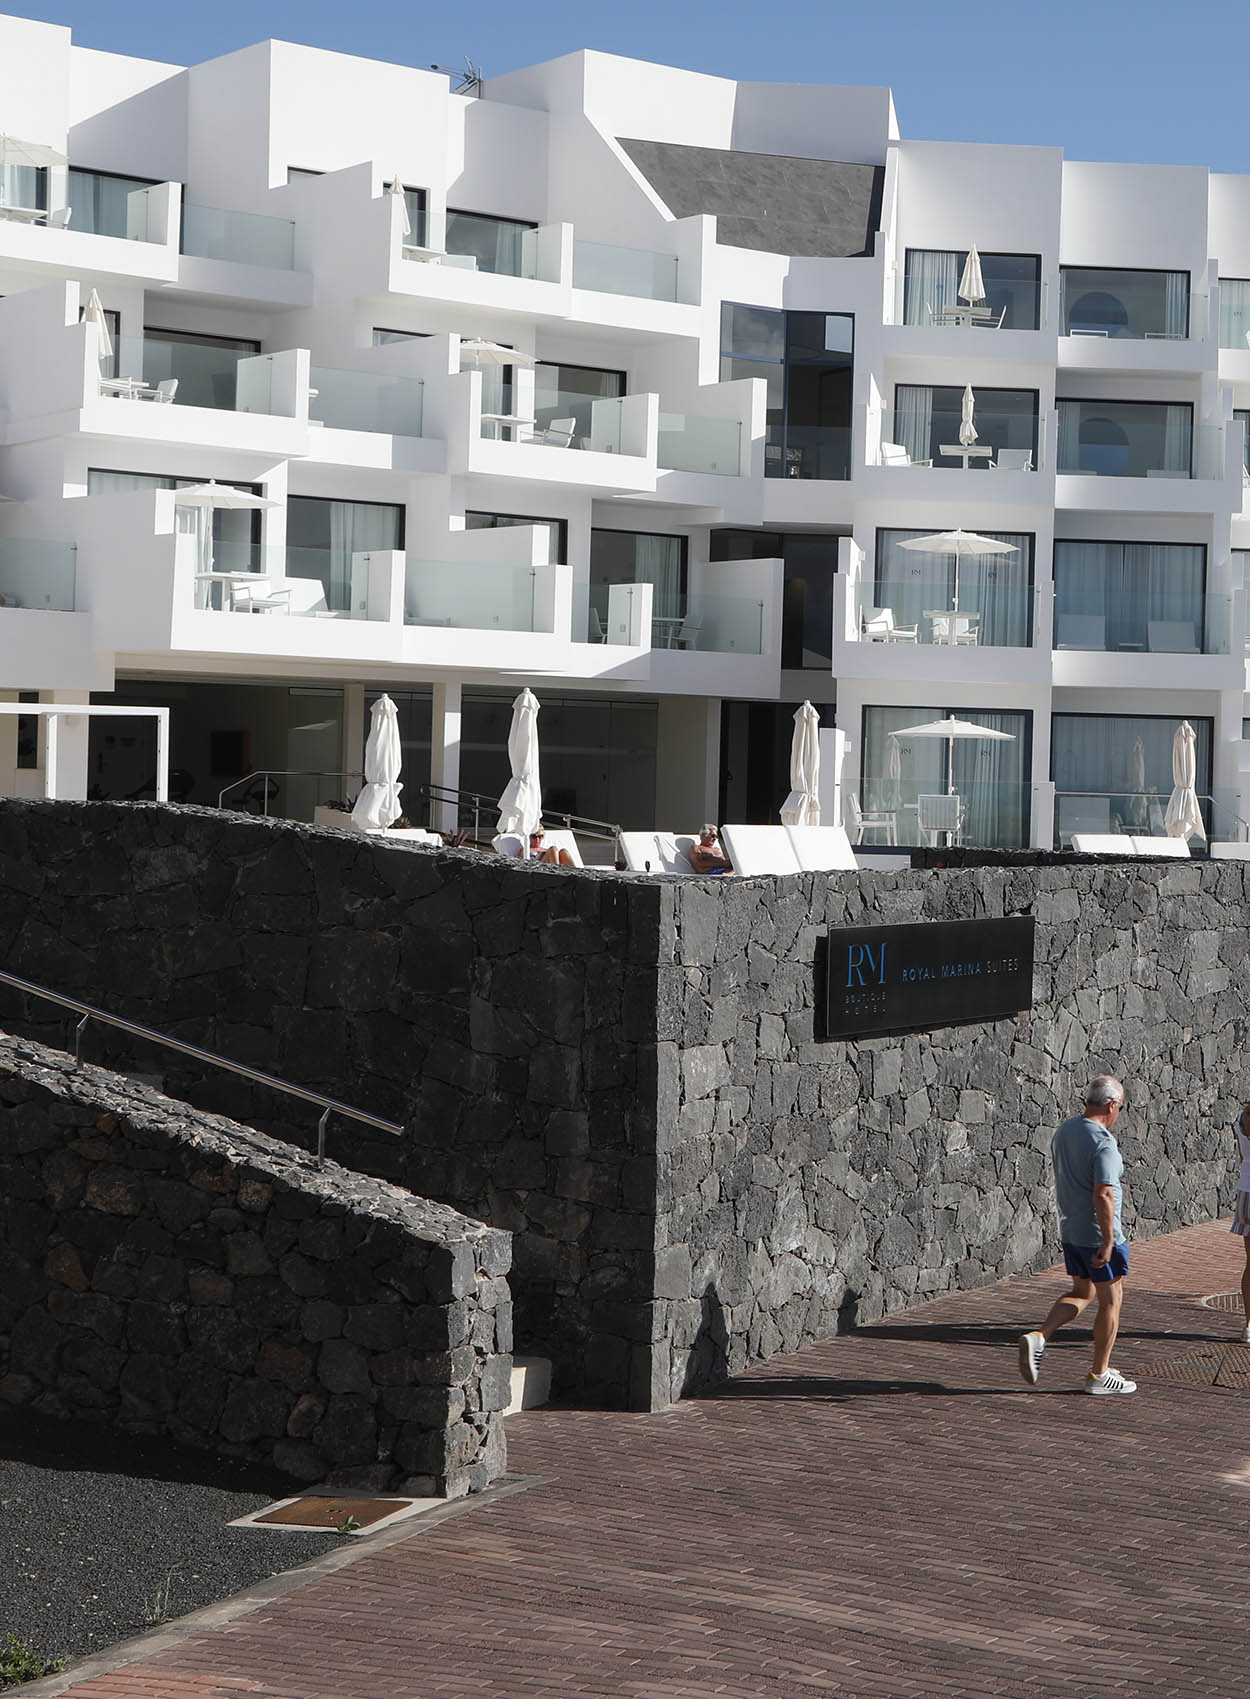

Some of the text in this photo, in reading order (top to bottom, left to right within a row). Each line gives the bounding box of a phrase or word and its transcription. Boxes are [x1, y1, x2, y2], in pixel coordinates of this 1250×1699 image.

[846, 942, 888, 987] RM
[902, 958, 1019, 982] ROYAL MARINA SUITES
